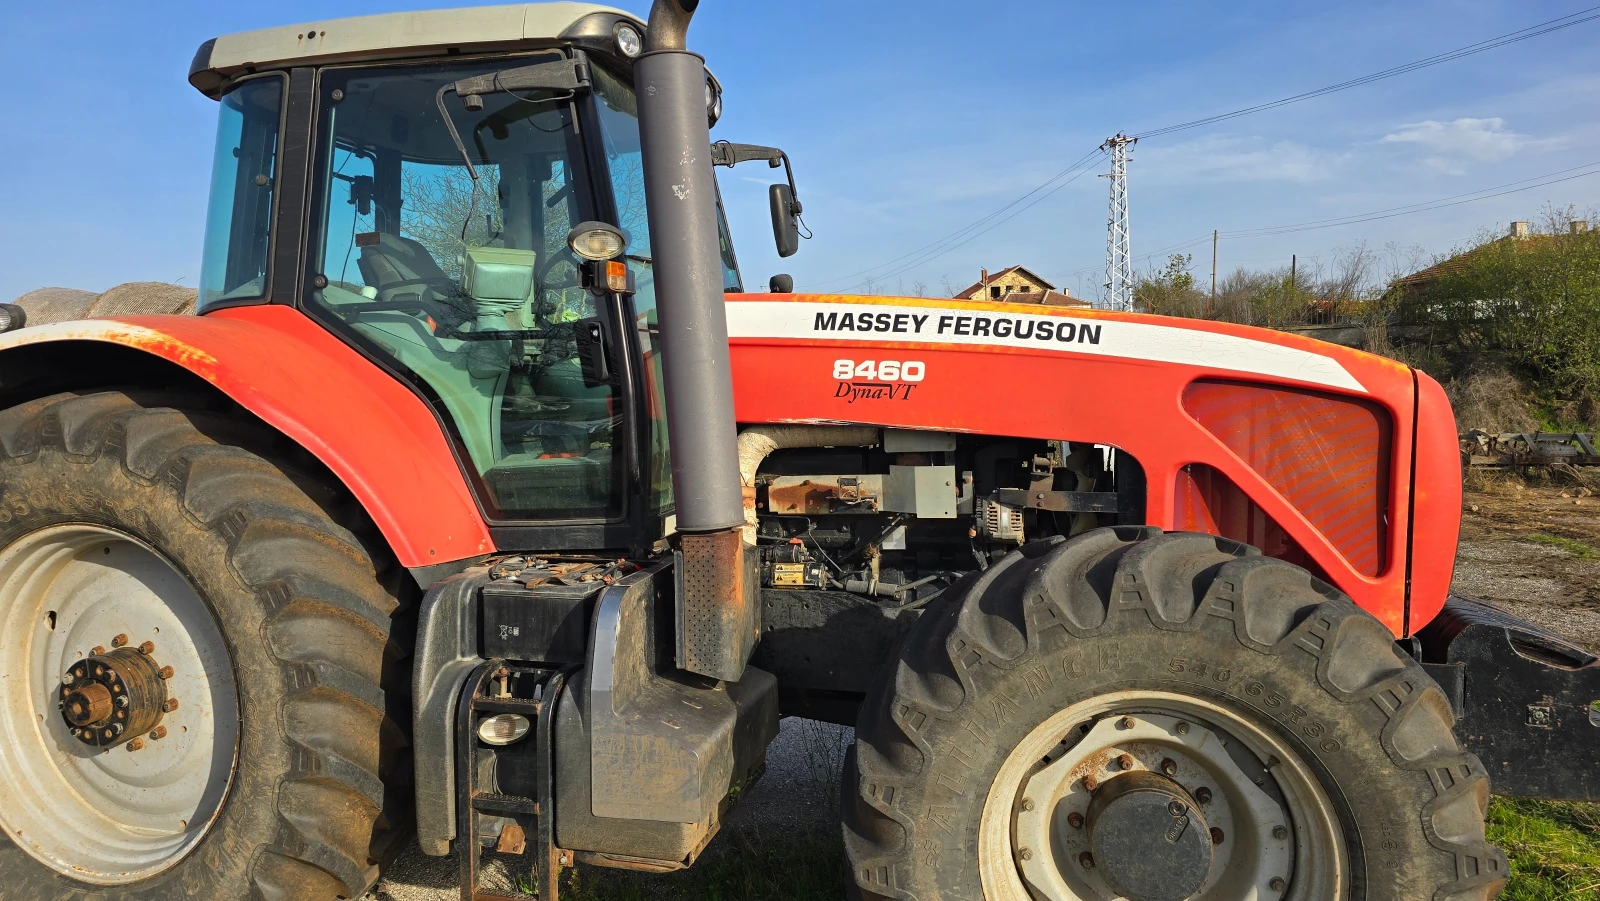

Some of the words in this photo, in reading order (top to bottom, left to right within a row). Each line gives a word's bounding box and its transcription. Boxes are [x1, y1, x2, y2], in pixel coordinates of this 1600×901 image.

[814, 312, 929, 333] MASSEY
[937, 315, 1102, 344] FERGUSON
[832, 359, 925, 381] 8460
[834, 382, 917, 403] Dyna-VT
[927, 640, 1124, 837] ALLIANCE
